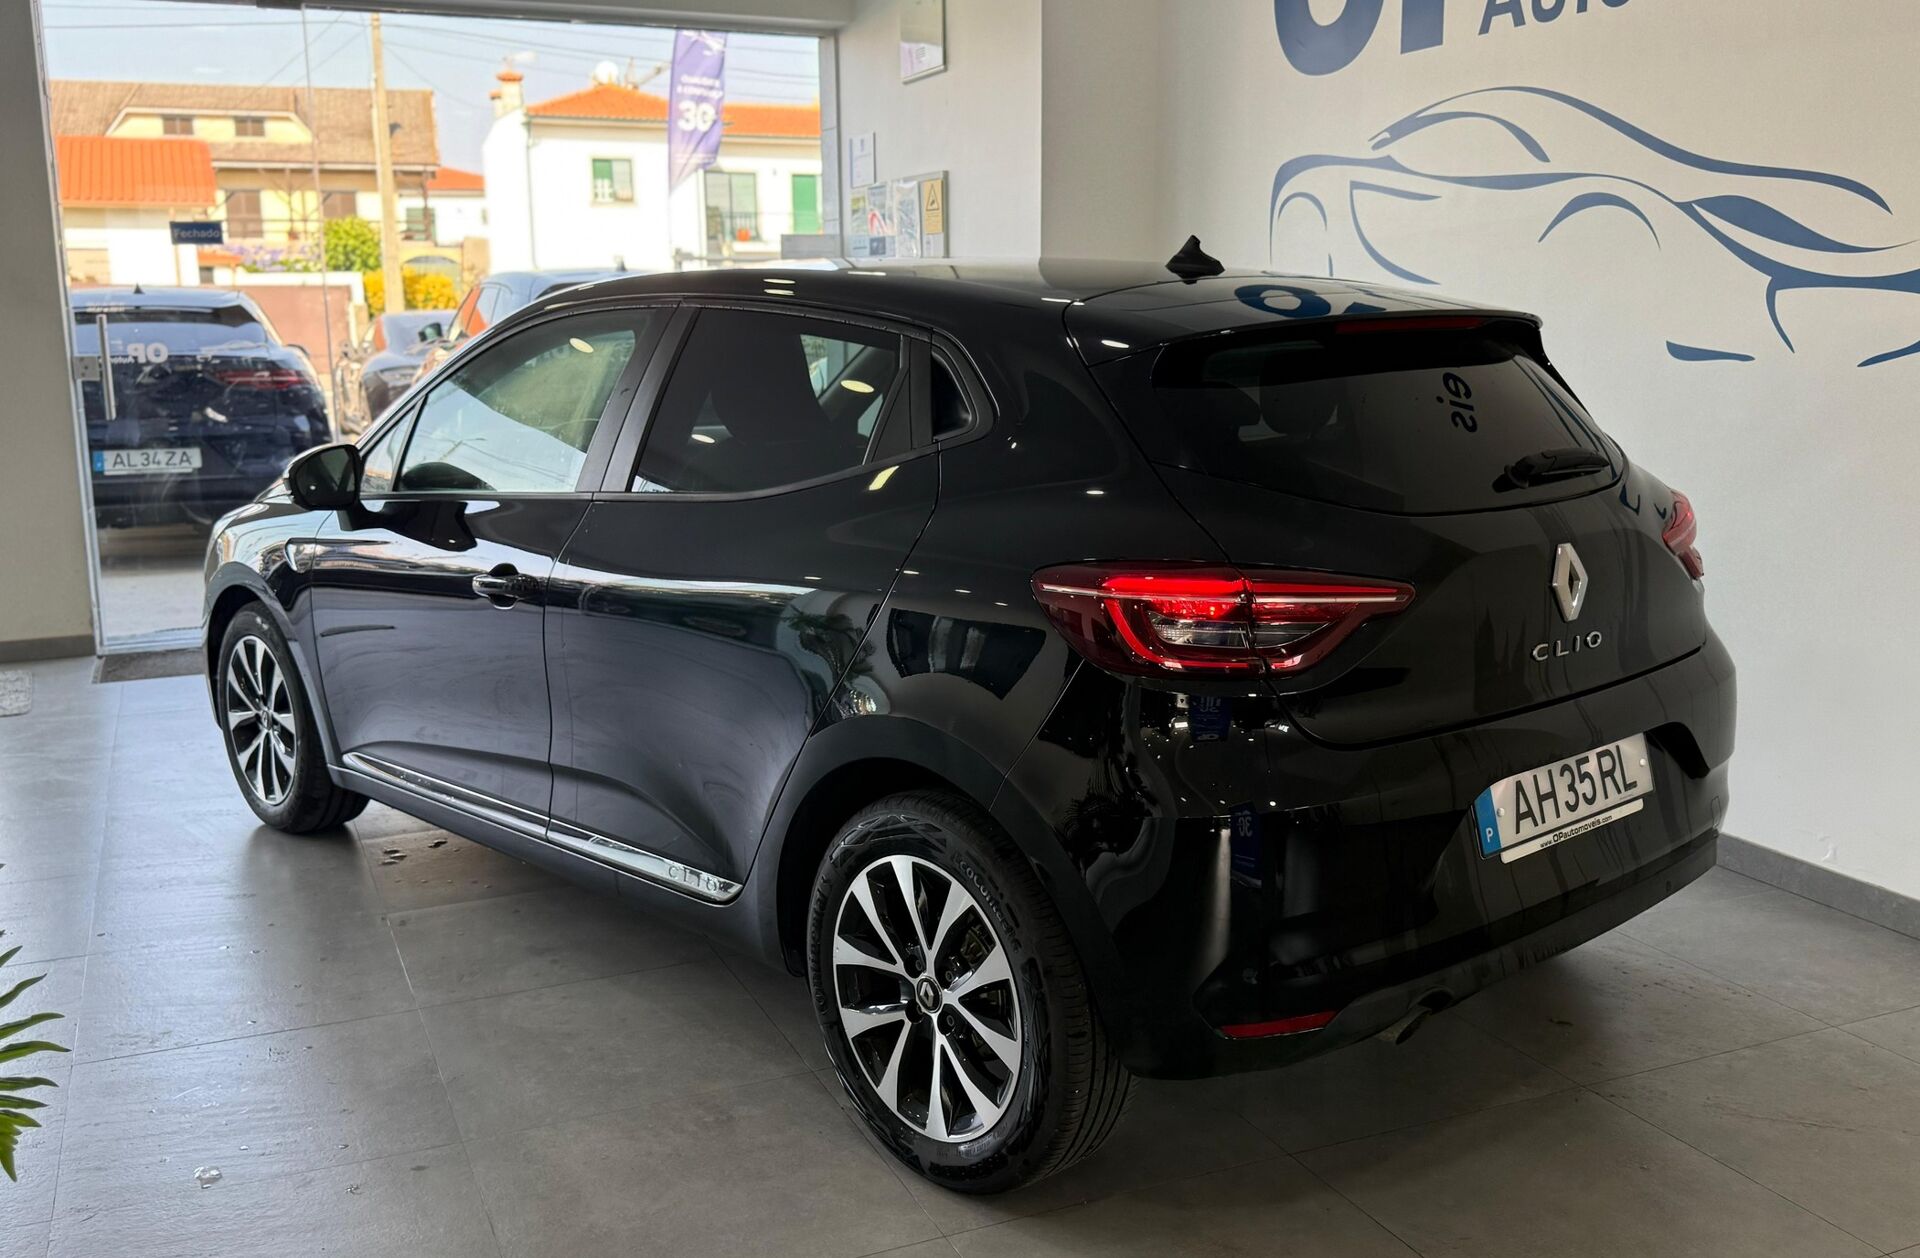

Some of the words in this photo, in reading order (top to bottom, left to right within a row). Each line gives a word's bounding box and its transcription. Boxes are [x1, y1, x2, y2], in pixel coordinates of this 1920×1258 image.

[173, 228, 220, 239] Fechado
[1532, 631, 1602, 661] CLIO
[1486, 826, 1494, 843] P
